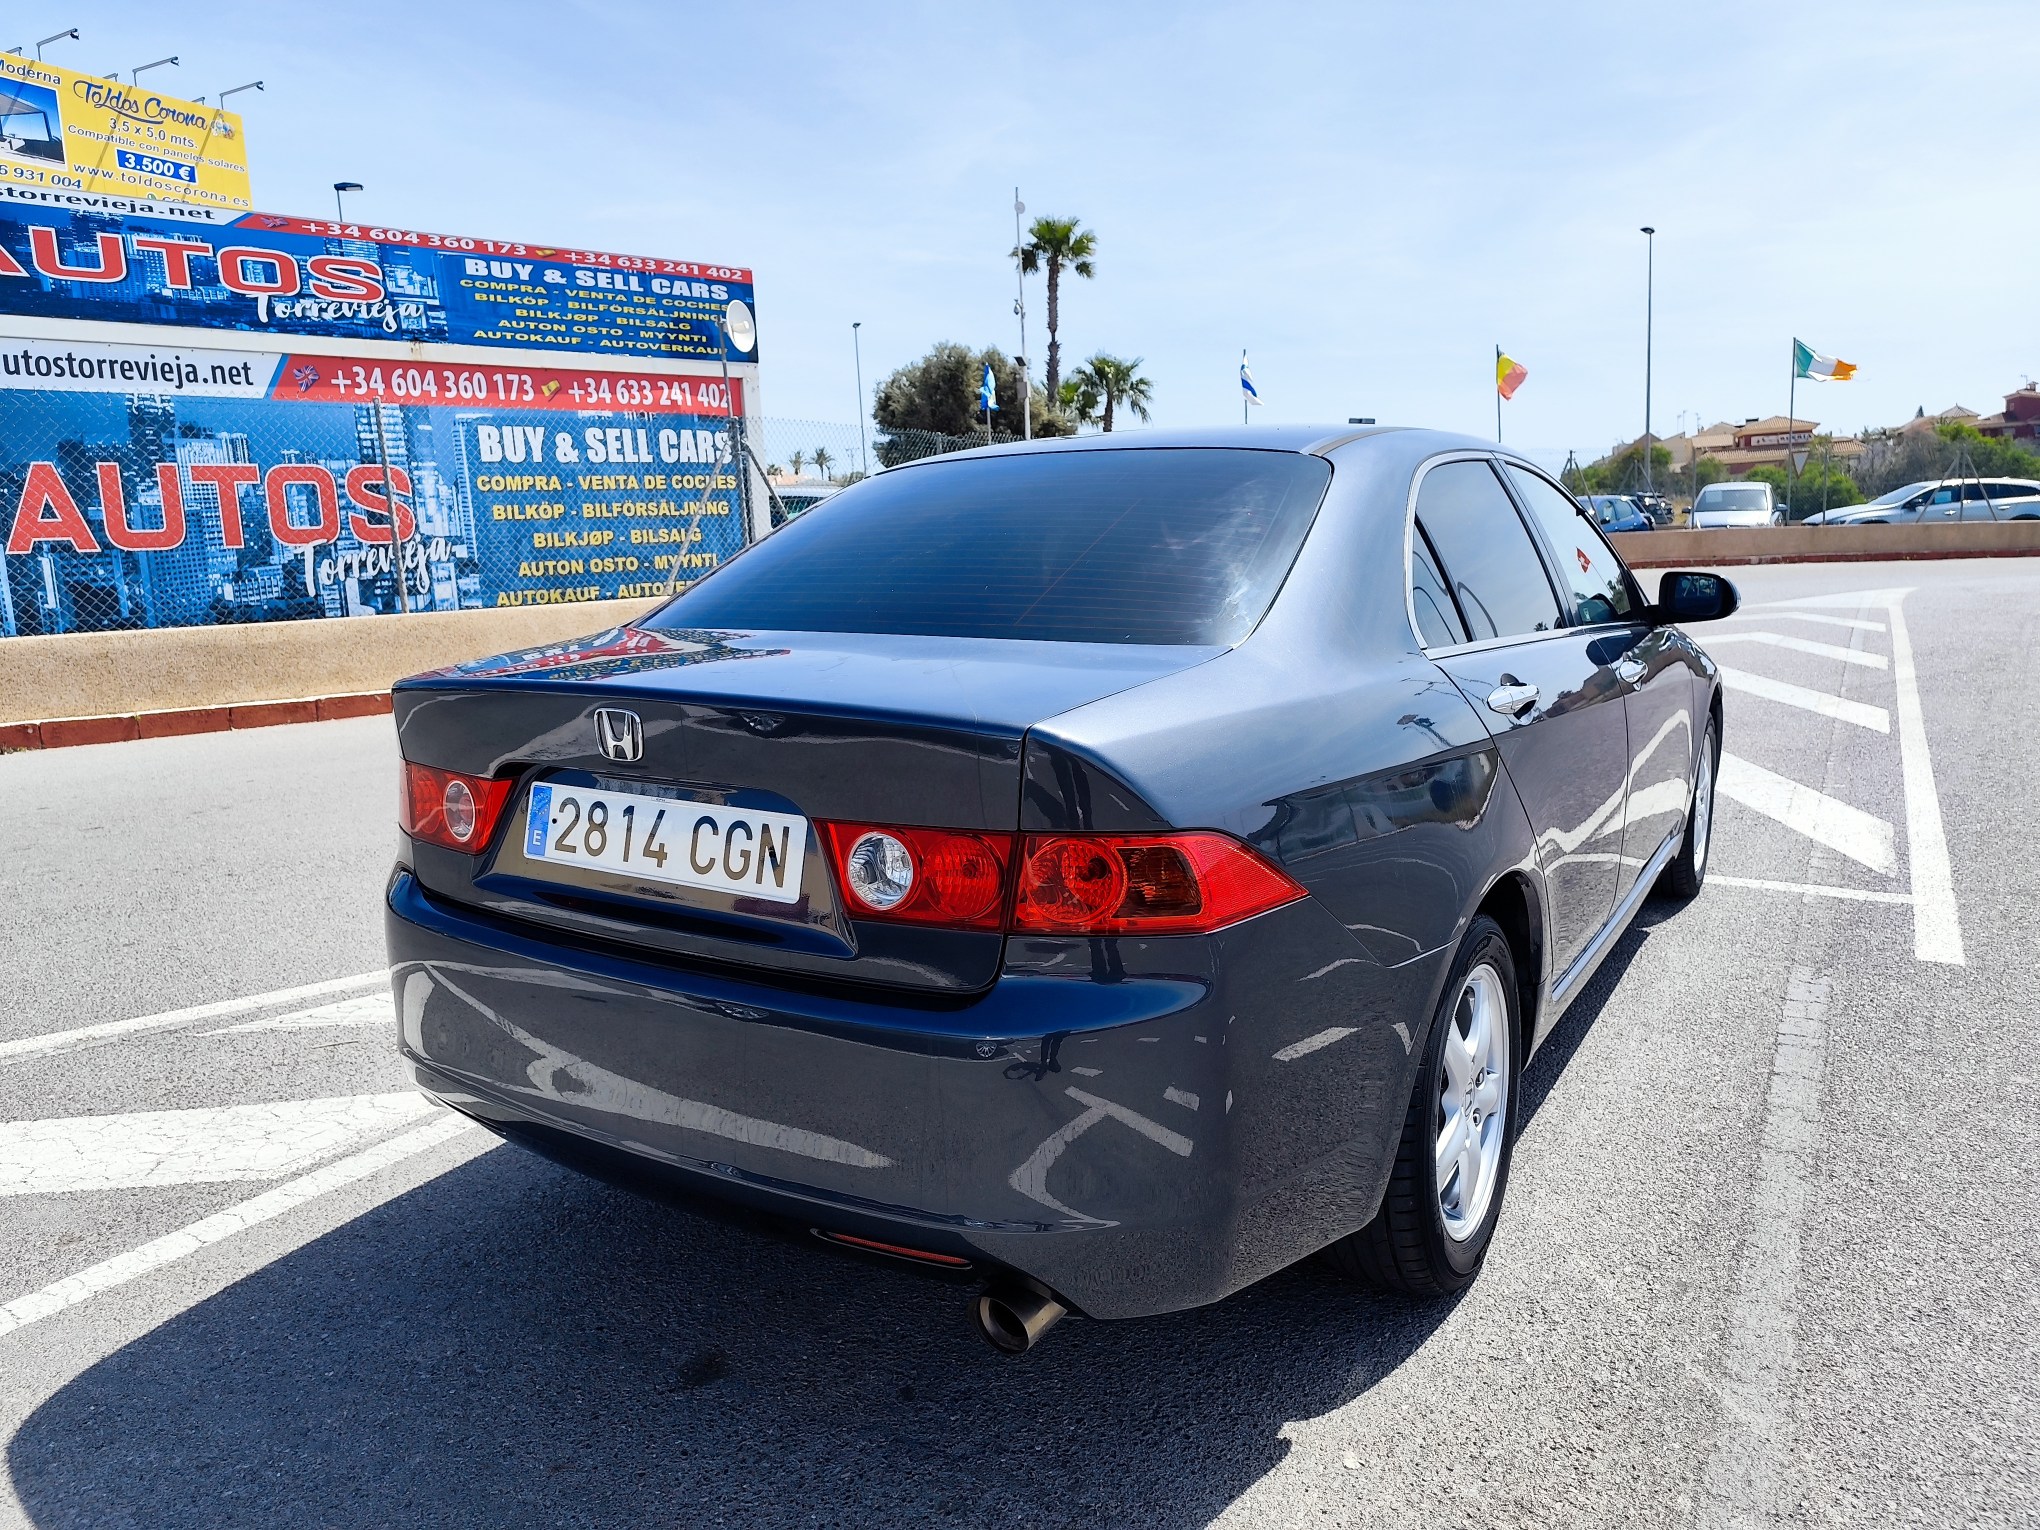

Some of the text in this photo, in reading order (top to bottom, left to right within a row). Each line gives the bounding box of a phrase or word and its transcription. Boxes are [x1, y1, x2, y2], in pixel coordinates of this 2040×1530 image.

[73, 80, 208, 130] Toldos Corona
[68, 124, 136, 147] Compatible
[139, 142, 160, 153] con
[207, 157, 246, 173] solares
[109, 118, 130, 133] 3,5
[146, 126, 166, 141] 5,0
[170, 133, 198, 149] mts.
[13, 167, 45, 182] 931
[51, 174, 82, 190] 004
[124, 153, 192, 181] 3.500 €
[73, 163, 250, 207] www.toldoscorona.es
[0, 187, 216, 220] torrevieja.net
[301, 223, 527, 256] +34 604 360 173
[464, 258, 729, 300] BUY & SELL CARS
[564, 251, 743, 281] +34 633 241 402
[459, 279, 548, 295] COMPRA
[564, 289, 628, 302] VENTA
[633, 296, 657, 305] DE
[662, 299, 729, 312] COCHES
[474, 293, 550, 307] BILKÖP
[246, 292, 425, 334] Torrevieja
[515, 309, 599, 323] BILKJØP
[616, 317, 692, 331] BILSALG
[473, 330, 582, 345] AUTOKAUF
[497, 320, 567, 332] AUTON
[572, 325, 623, 337] OSTO
[639, 331, 707, 343] MYYNTI
[331, 365, 535, 402] +34 604 360 173
[568, 377, 729, 409] +34 633 241 402
[477, 425, 734, 464] BUY & SELL CARS
[476, 475, 562, 491] COMPRA
[578, 474, 639, 490] VENTA
[644, 475, 667, 490] DE
[6, 460, 416, 555] AUTOS
[492, 501, 565, 520] BILKÖP
[533, 530, 614, 548] BILKJØP
[297, 535, 453, 598] Torreveja
[518, 559, 584, 577] AUTON
[589, 556, 639, 573] OSTO
[496, 585, 600, 607] AUTOKAUF
[531, 797, 790, 888] E 2814 CGN
